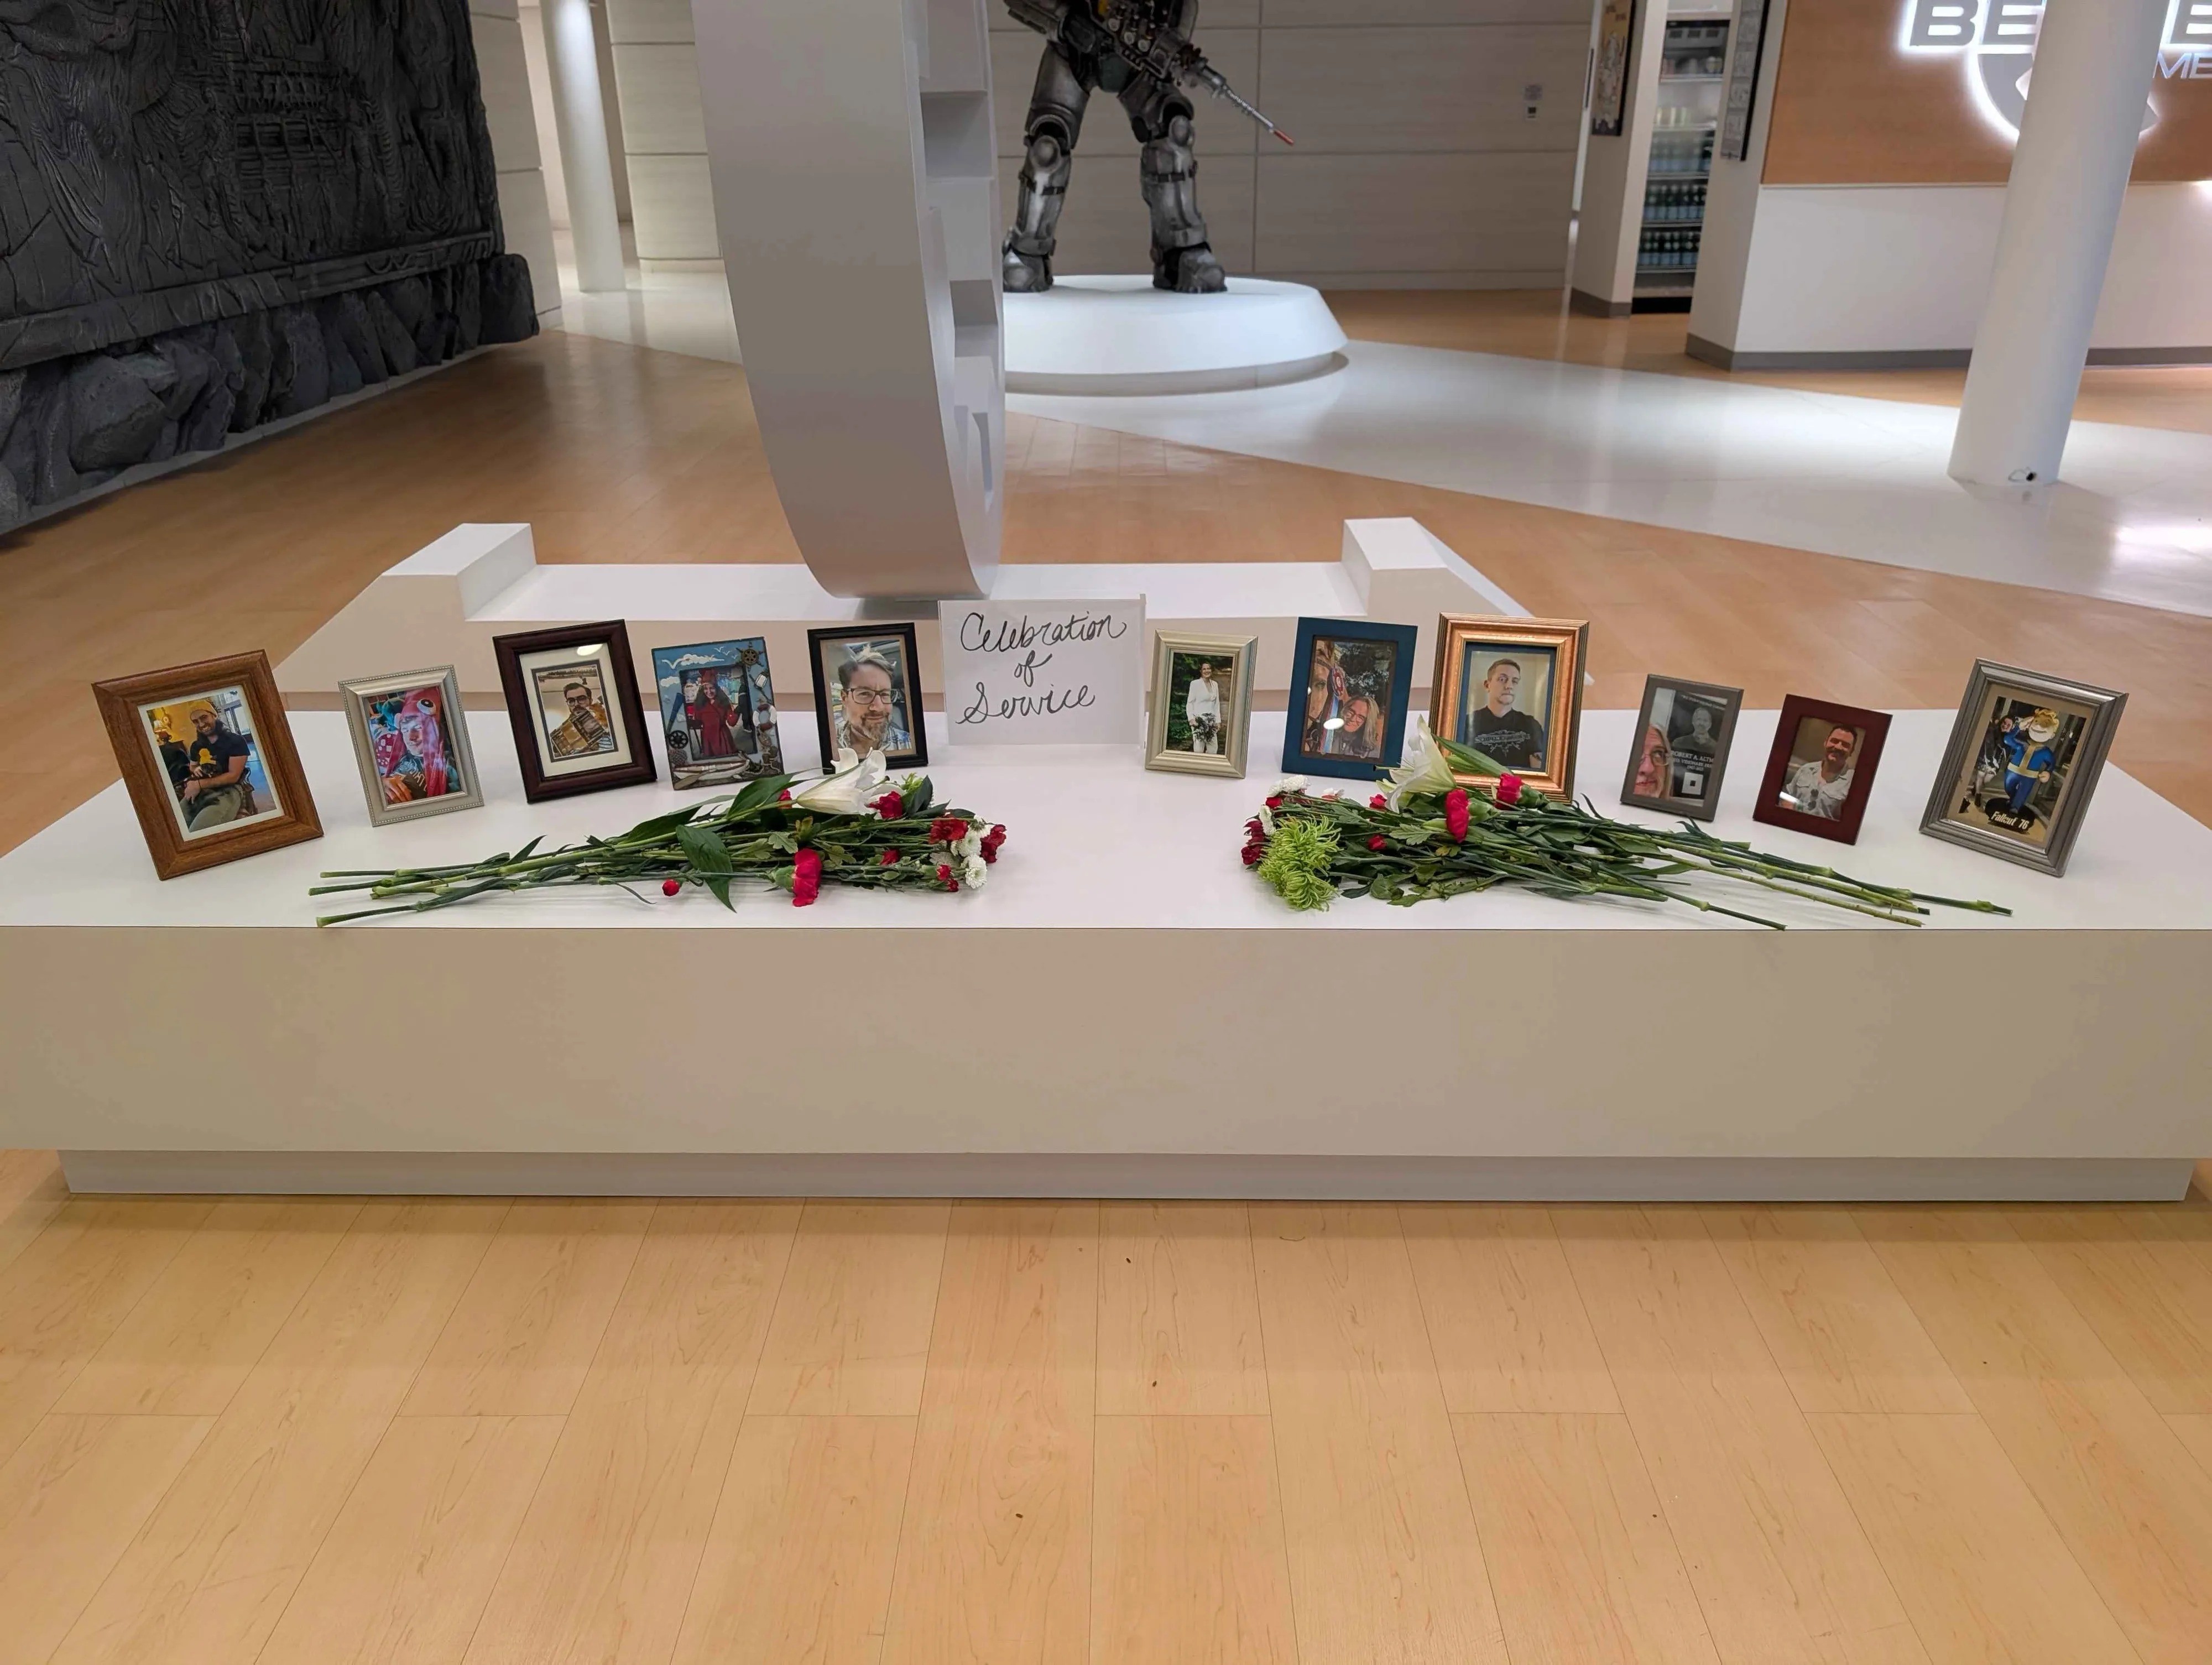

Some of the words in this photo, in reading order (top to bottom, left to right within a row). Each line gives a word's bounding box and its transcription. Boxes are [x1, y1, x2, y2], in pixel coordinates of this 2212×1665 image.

[961, 611, 1127, 653] Celebration
[1014, 650, 1053, 687] of
[956, 682, 1095, 724] Service
[1991, 811, 2018, 826] Fallout
[2018, 818, 2030, 829] 76
